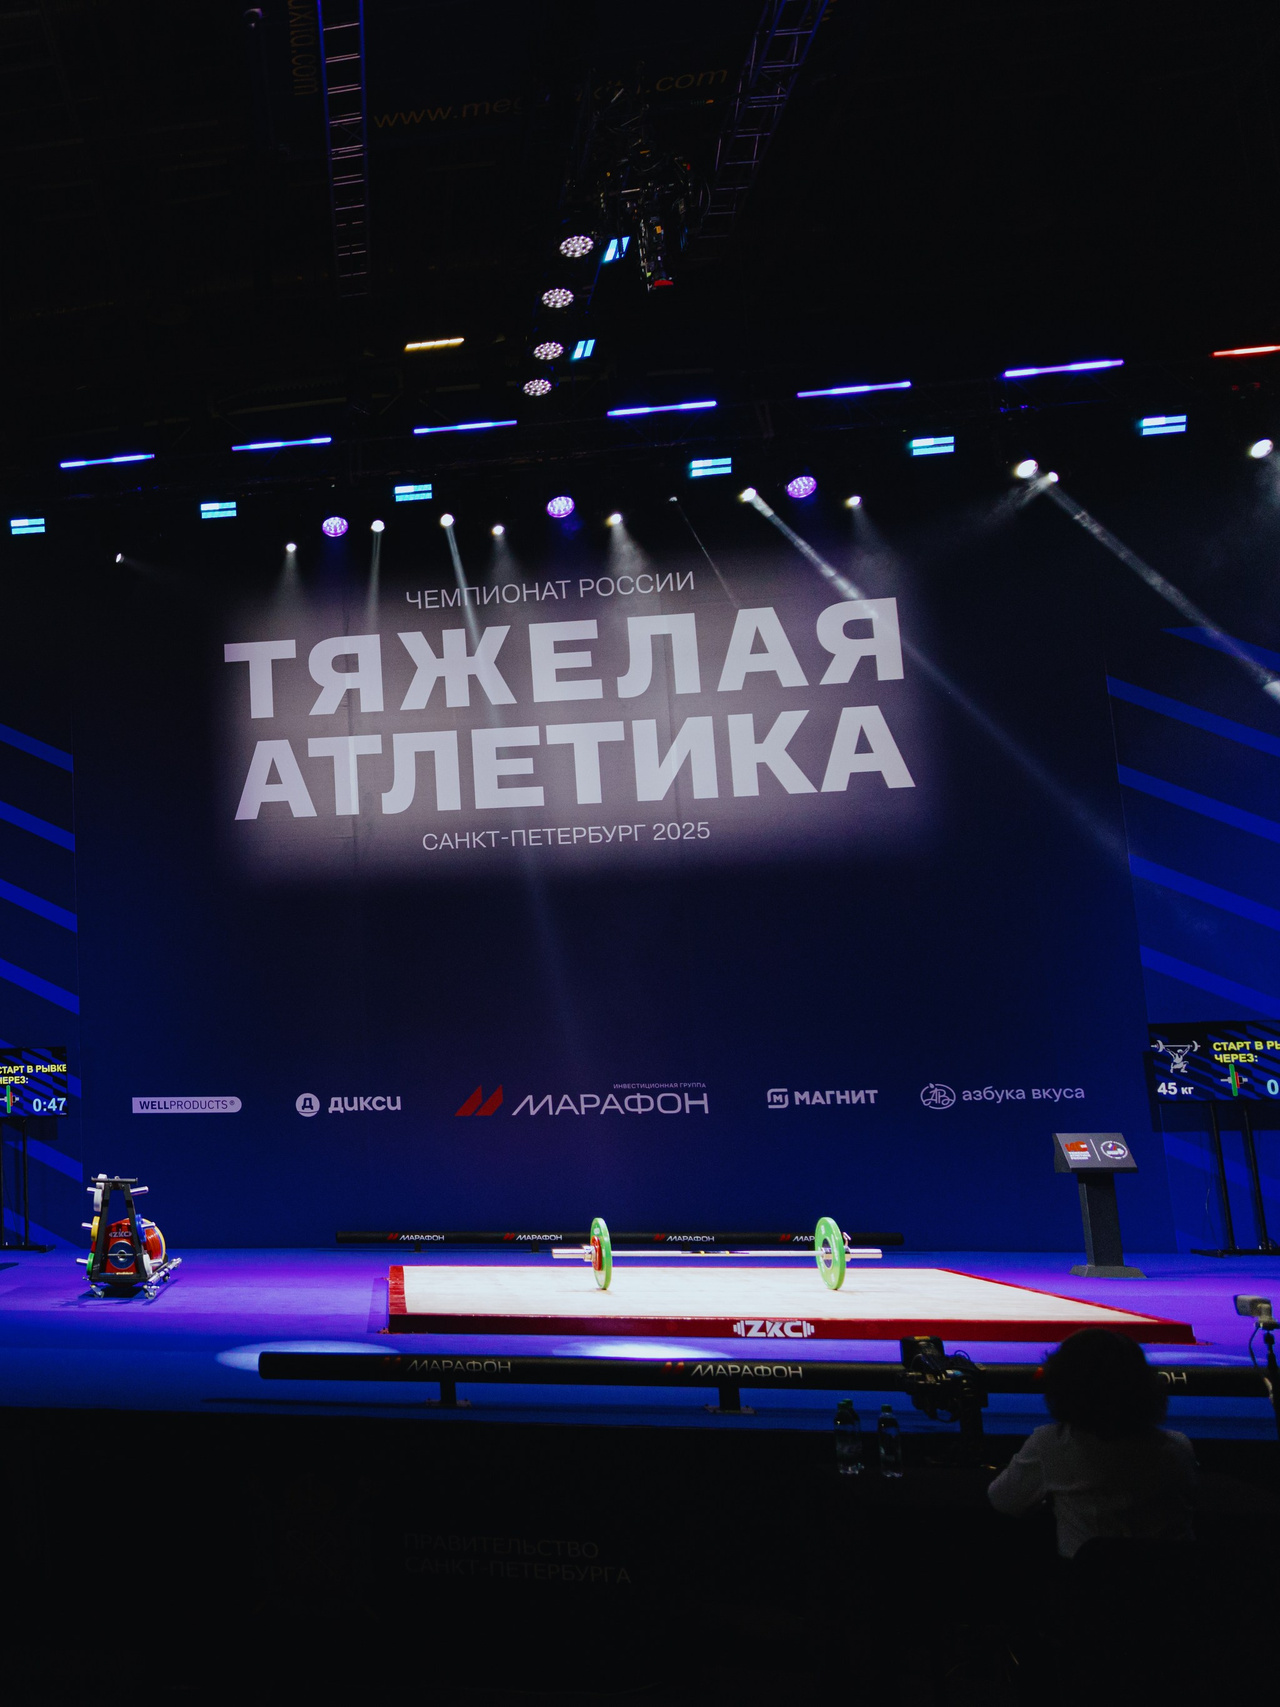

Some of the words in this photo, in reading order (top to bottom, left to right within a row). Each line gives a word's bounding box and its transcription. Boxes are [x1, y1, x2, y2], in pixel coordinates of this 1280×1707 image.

[406, 579, 571, 610] ЧЕМПИОНАТ
[578, 570, 696, 599] РОССИИ
[223, 596, 904, 719] ТЯЖЕЛАЯ
[234, 705, 916, 821] АТЛЕТИКА
[422, 823, 646, 851] САНКТ-ПЕТЕРБУРГ
[652, 821, 711, 843] 2025
[1212, 1041, 1252, 1051] СТАРТ
[1254, 1041, 1264, 1051] В
[1214, 1053, 1259, 1063] ЧЕРЕЗ:
[27, 1065, 33, 1074] В
[35, 1064, 67, 1073] РЫВКЕ
[613, 1082, 679, 1090] ИНВЕСТИЦИОННАЯ
[962, 1085, 1026, 1104] азбука
[1031, 1087, 1085, 1103] вкуса
[1157, 1082, 1178, 1095] 45
[32, 1097, 67, 1112] 0:47
[511, 1093, 709, 1116] МАРАФОН
[794, 1089, 878, 1106] МАГНИТ
[666, 1235, 715, 1243] МАРАФОН
[744, 1320, 804, 1338] ZKC
[407, 1359, 511, 1374] МАРАФОН
[691, 1364, 803, 1379] МАРАФОН
[403, 1532, 600, 1559] ПРАВИТЕЛЬСТВО
[404, 1556, 632, 1584] САНКТ-ПЕТЕРБУРГА
